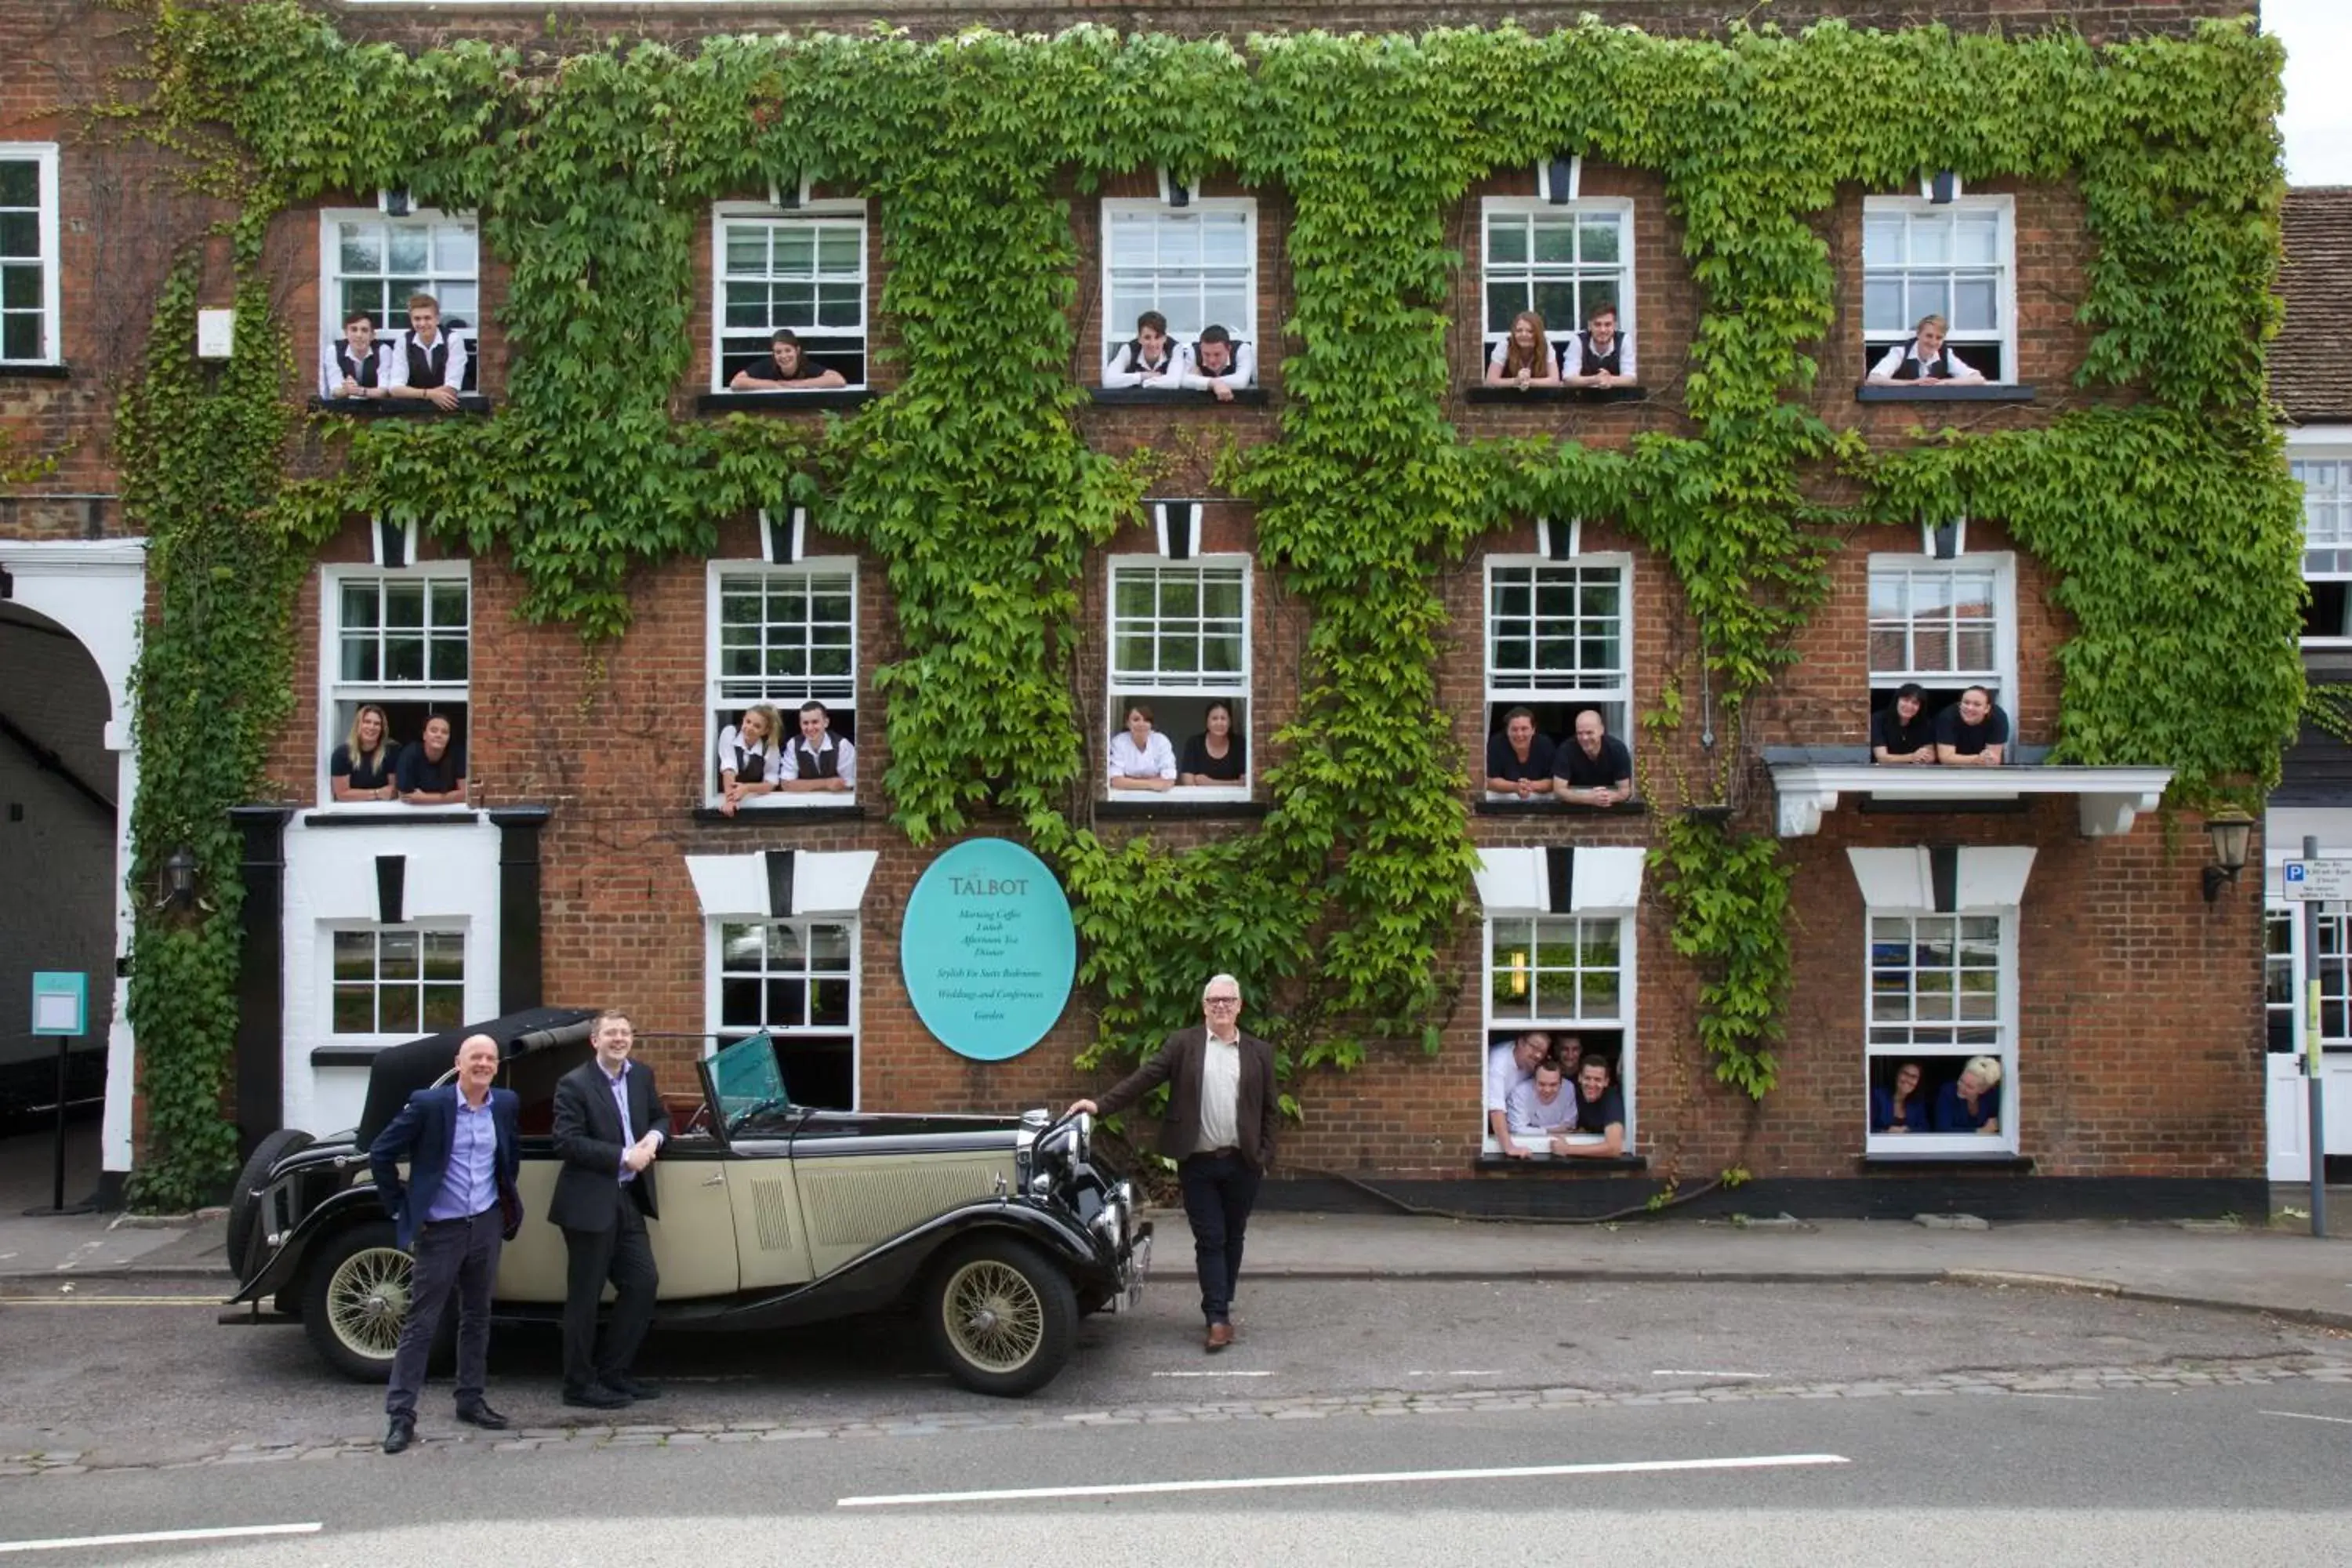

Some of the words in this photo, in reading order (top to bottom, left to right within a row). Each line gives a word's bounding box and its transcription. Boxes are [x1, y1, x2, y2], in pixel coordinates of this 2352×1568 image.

[2290, 866, 2302, 880] P
[948, 877, 1029, 895] TALBOT
[959, 909, 994, 921] Morning
[996, 909, 1022, 921] Coffee
[976, 923, 1003, 931] Lunch
[960, 934, 1001, 947] Afternoon
[1004, 935, 1018, 946] Tea
[974, 948, 1005, 957] Dinner
[938, 988, 977, 1000] Weddings
[978, 989, 994, 998] and
[996, 989, 1044, 1000] Conferences
[974, 1010, 1004, 1020] Garden
